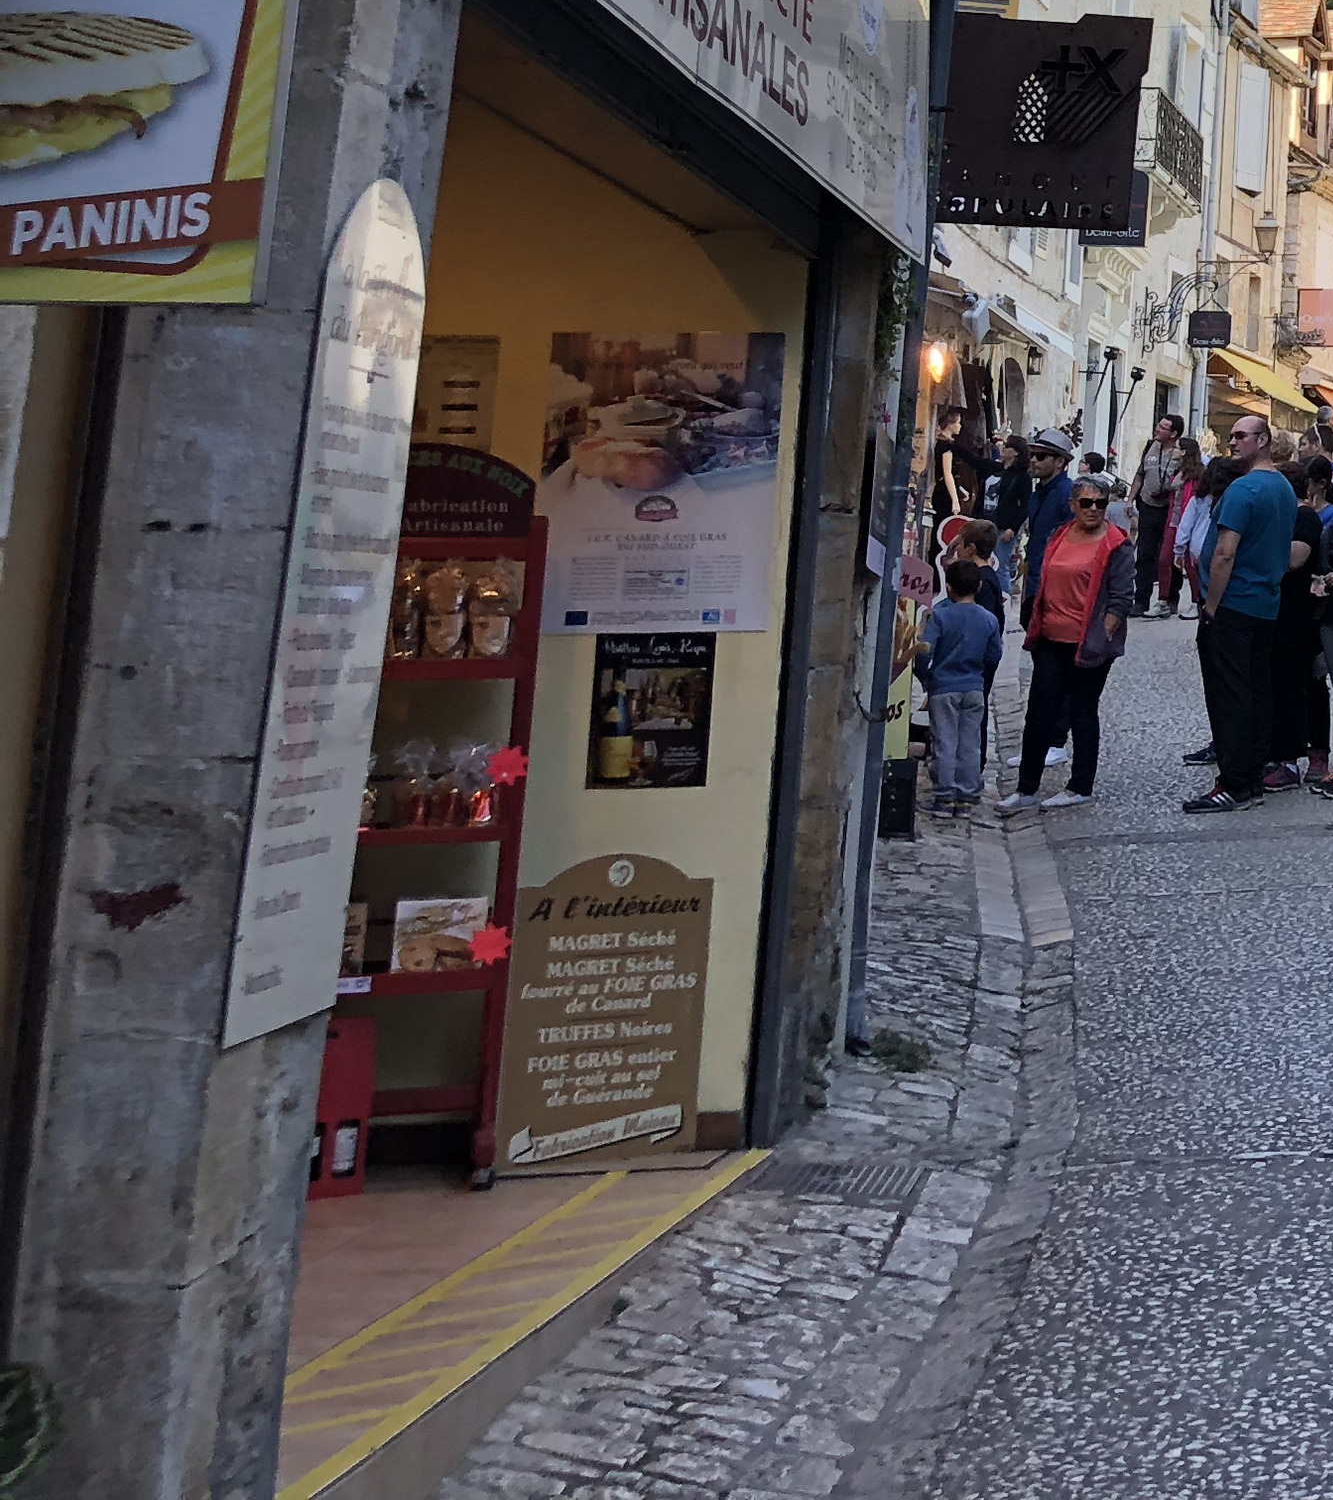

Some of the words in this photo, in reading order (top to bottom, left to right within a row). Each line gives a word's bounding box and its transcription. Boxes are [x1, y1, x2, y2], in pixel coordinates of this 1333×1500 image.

[10, 192, 211, 257] PANINIS
[407, 498, 509, 514] abrication
[564, 895, 701, 920] l'intérieur
[549, 933, 622, 951] MAGRET
[628, 929, 676, 948] Séché
[547, 958, 621, 978] MAGRET
[625, 954, 675, 973] Séché
[579, 984, 599, 995] au
[604, 975, 646, 993] FOIE
[650, 972, 698, 990] GRAS
[565, 998, 586, 1015] de
[592, 992, 652, 1012] Canard
[538, 1022, 615, 1043] TRUFFES
[619, 1019, 672, 1038] Noires
[527, 1055, 569, 1074] FOIE
[574, 1050, 622, 1070] GRAS
[628, 1048, 678, 1065] entier
[547, 1090, 568, 1108] de
